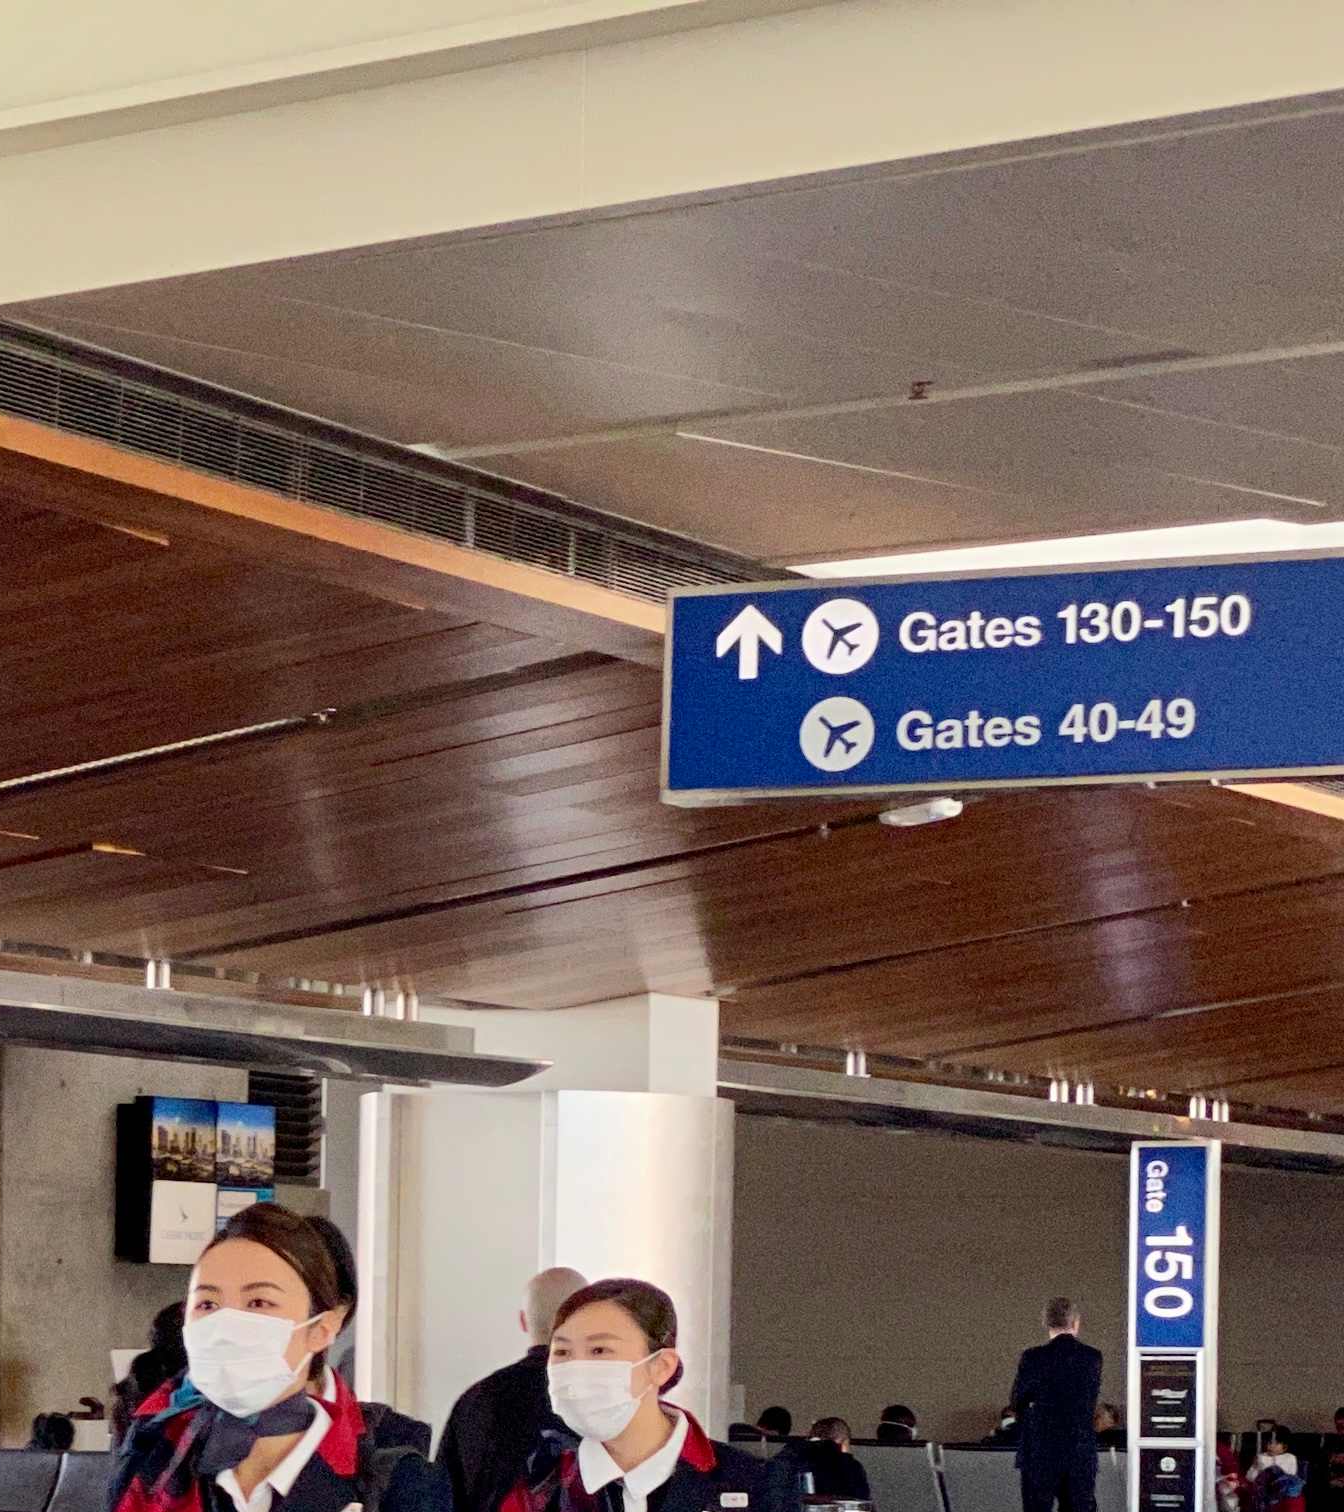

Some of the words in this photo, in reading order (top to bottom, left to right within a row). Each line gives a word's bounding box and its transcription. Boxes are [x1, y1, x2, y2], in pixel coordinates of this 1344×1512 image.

[899, 611, 1042, 652] Gates
[1057, 594, 1251, 643] 130-150
[897, 711, 1041, 750] Gates
[1059, 698, 1195, 742] 40-49
[1145, 1161, 1168, 1213] Gate
[1144, 1225, 1193, 1318] 150
